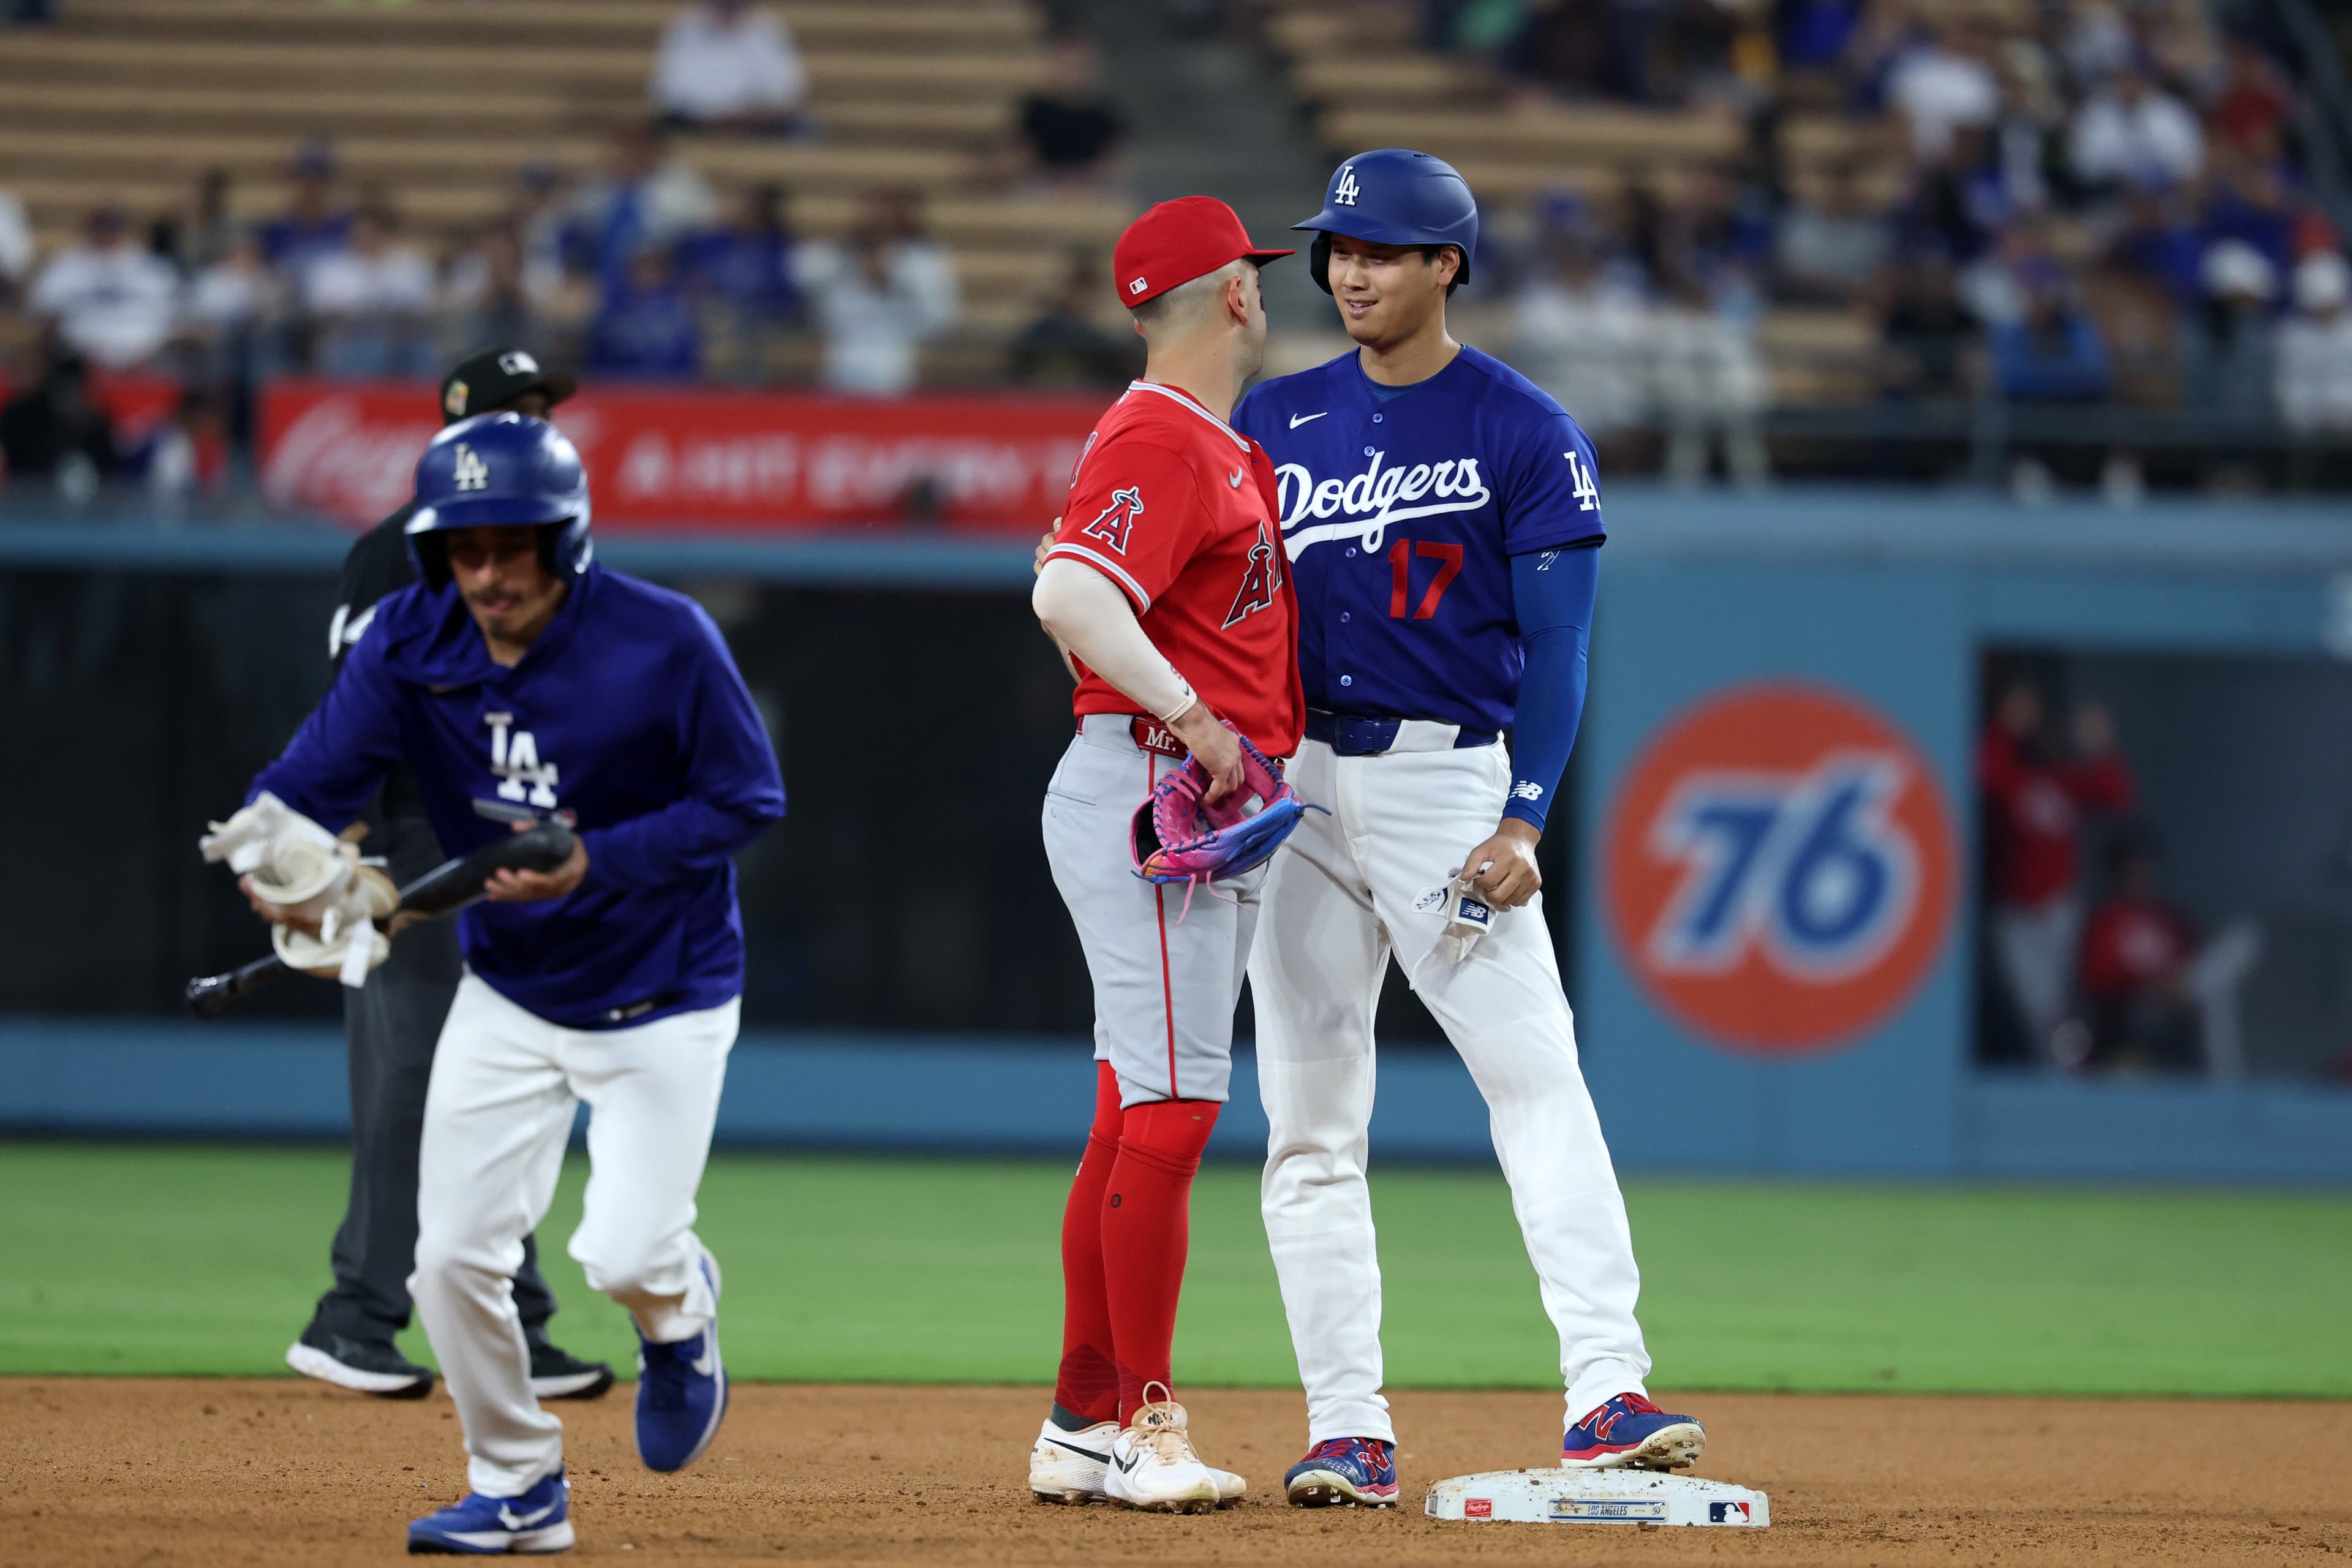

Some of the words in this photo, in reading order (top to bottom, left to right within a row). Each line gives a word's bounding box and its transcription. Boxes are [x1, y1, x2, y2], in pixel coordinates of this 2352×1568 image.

[1335, 166, 1360, 206] LA
[454, 442, 489, 491] LA
[1563, 451, 1601, 511] LA
[1082, 486, 1144, 556] A
[1275, 450, 1490, 554] Dodgers
[1221, 520, 1283, 631] A
[1388, 538, 1463, 620] 17
[484, 712, 559, 809] LA
[1144, 726, 1177, 752] Mr.
[1654, 755, 1920, 979] 76
[1578, 1404, 1624, 1441] N
[1587, 1505, 1599, 1515] LOS
[1600, 1505, 1628, 1516] ANGELES
